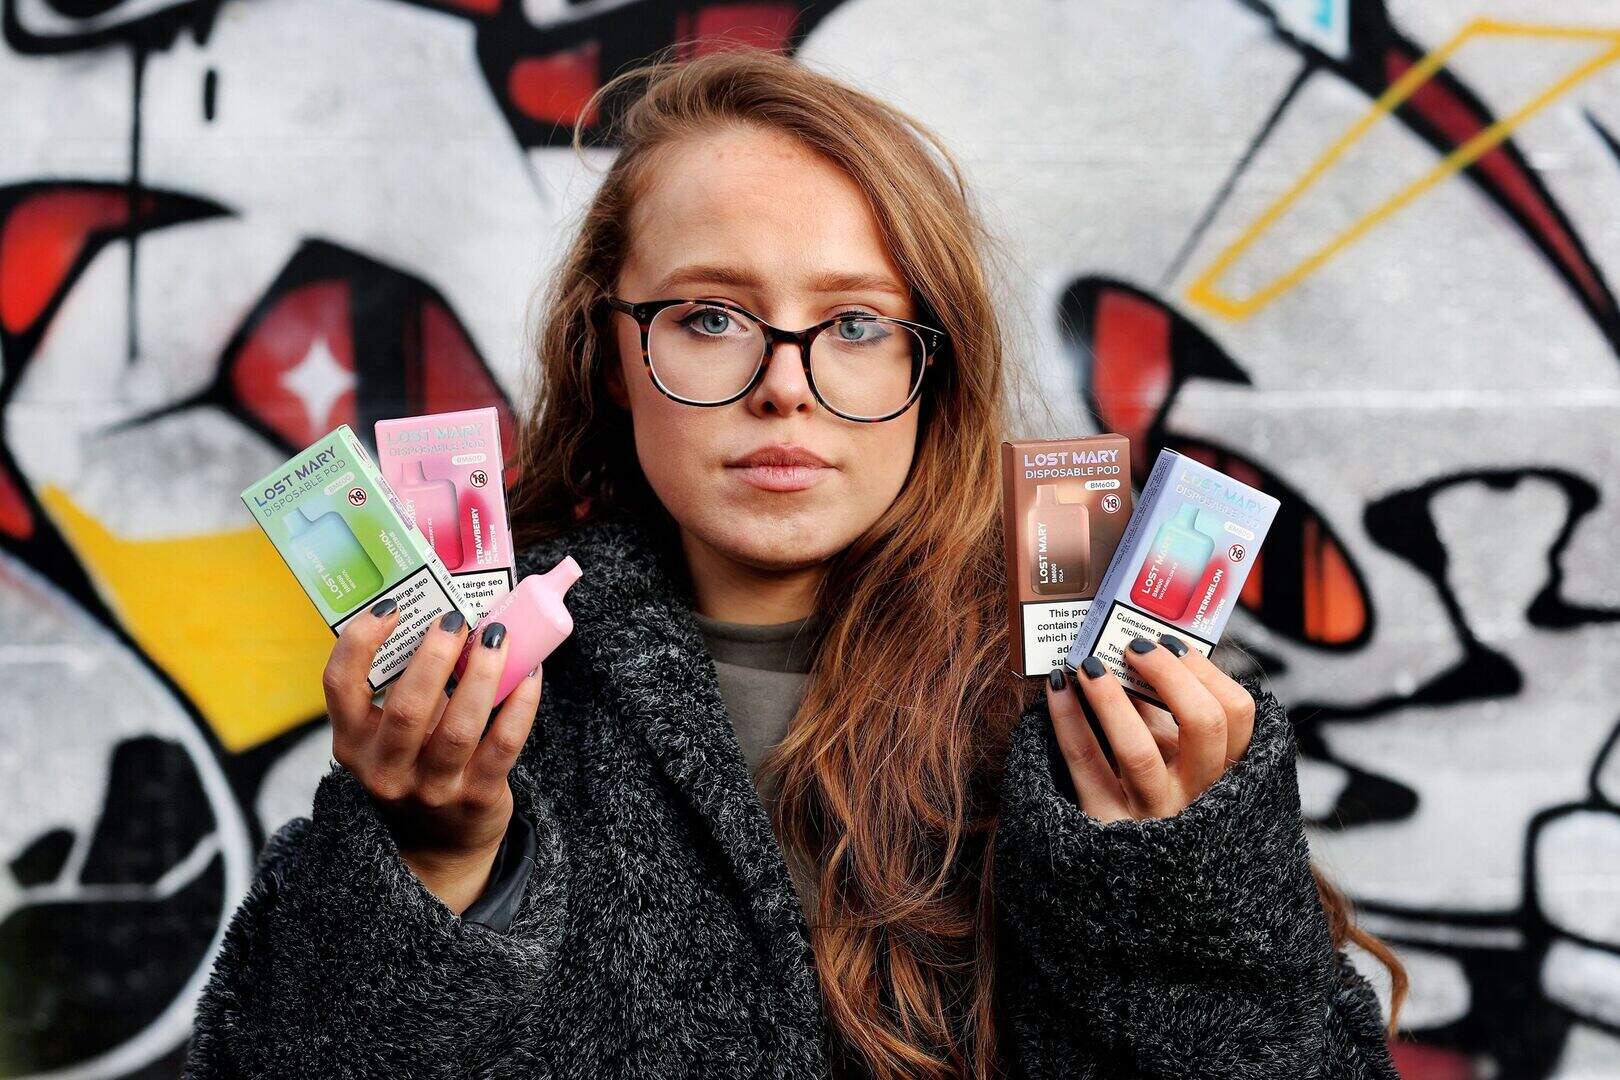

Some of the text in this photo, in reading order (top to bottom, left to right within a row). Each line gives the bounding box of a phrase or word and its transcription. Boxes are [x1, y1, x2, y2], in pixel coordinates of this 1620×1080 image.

[387, 423, 483, 445] LOST MARY
[389, 440, 485, 456] DISPOSABLE POD
[1024, 449, 1119, 467] LOST MARY
[254, 474, 294, 509] LOST
[294, 446, 337, 480] MARY
[1025, 466, 1120, 479] DISPOSABLE POD
[263, 459, 346, 518] DISPOSABLE POD
[1090, 481, 1116, 489] BM600
[1224, 488, 1266, 514] MARY
[470, 507, 485, 564] STRAWBERRY
[377, 528, 408, 571] MENTHOL
[1038, 522, 1048, 584] LOST MARY
[414, 577, 428, 589] seo
[463, 579, 503, 589] táirge seo
[1141, 565, 1160, 594] LOST
[464, 590, 494, 599] bstaint
[1190, 568, 1223, 629] WATERMELON
[1049, 609, 1070, 618] This
[383, 627, 411, 650] product
[411, 606, 443, 629] contains
[1038, 621, 1078, 631] contains
[1037, 633, 1078, 643] which is
[371, 650, 396, 669] icotine
[396, 635, 418, 652] which
[418, 630, 426, 638] is
[1108, 643, 1124, 655] This
[381, 650, 414, 674] addictive
[1097, 651, 1125, 668] nicotine
